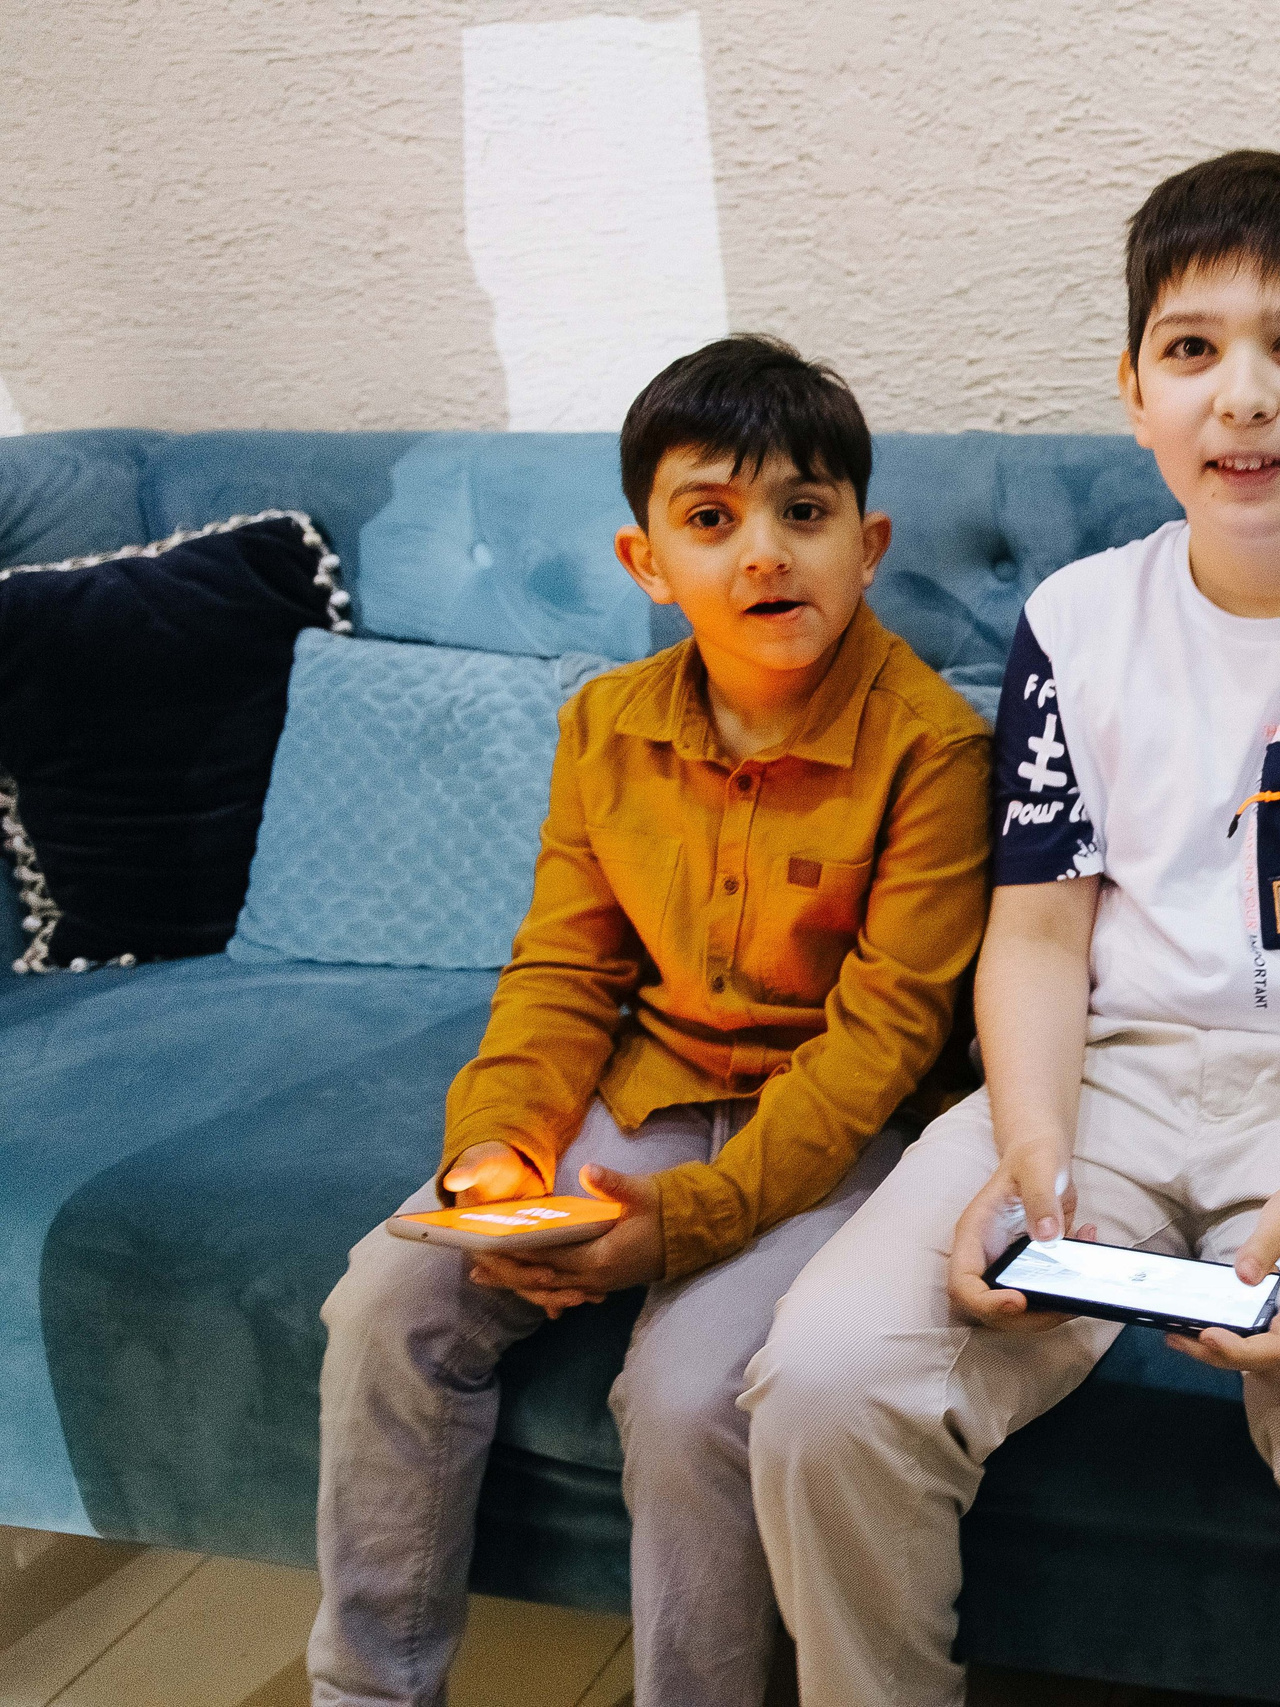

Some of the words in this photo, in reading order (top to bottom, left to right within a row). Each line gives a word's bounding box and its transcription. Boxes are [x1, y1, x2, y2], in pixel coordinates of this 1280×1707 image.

[1002, 800, 1064, 836] pour
[1243, 887, 1257, 929] YOUR
[1249, 934, 1268, 1010] IMPORTANT
